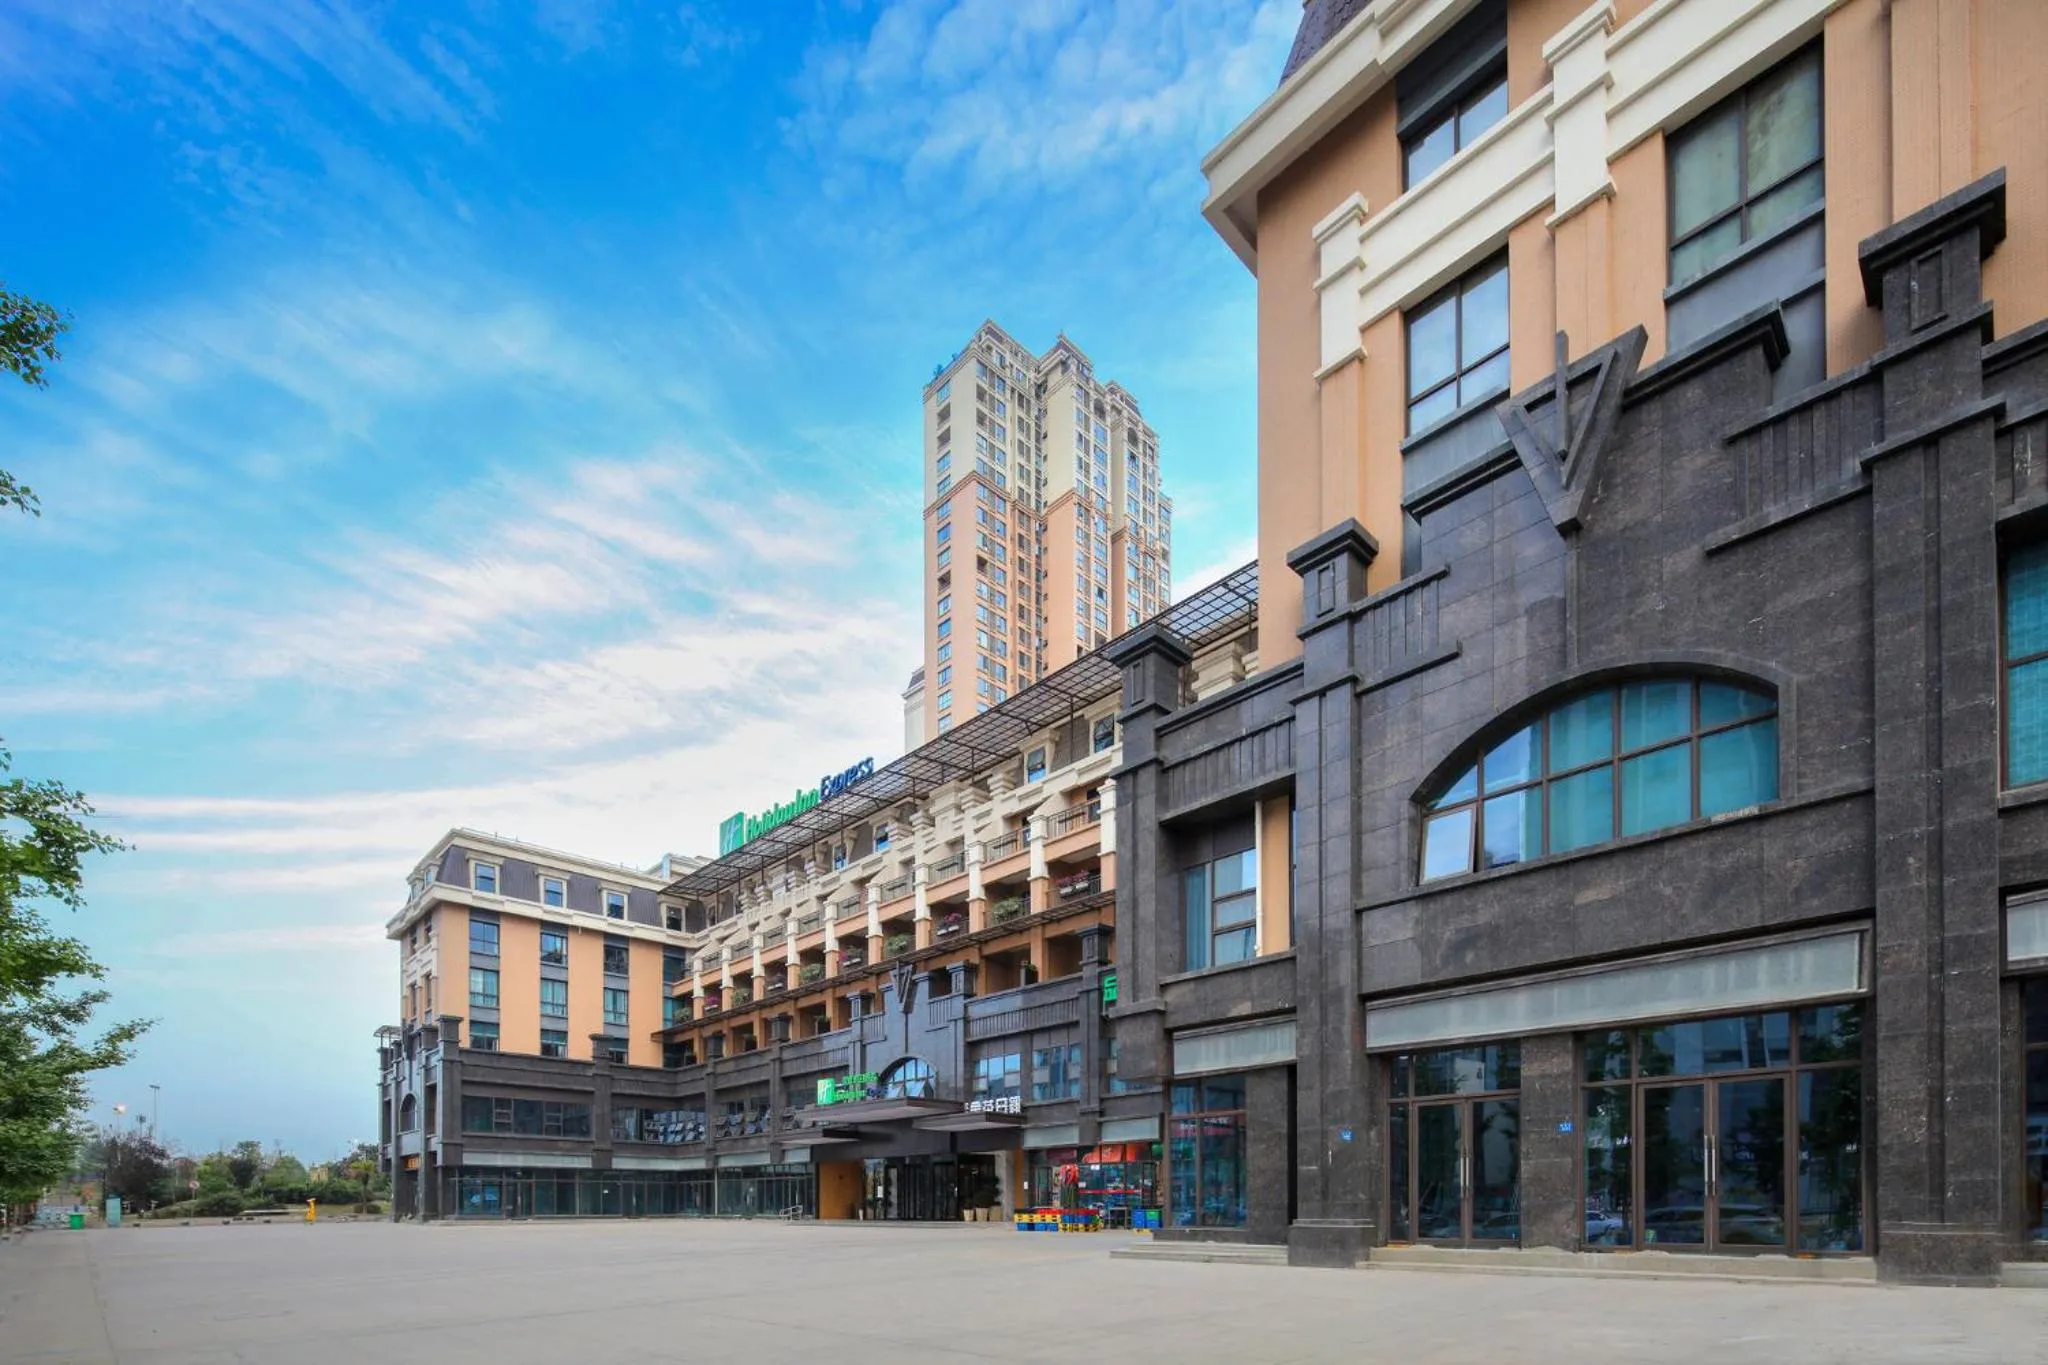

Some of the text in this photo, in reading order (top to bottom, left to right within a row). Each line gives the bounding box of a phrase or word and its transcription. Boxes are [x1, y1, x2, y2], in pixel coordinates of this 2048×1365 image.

[747, 757, 874, 841] Holiday Inn Express
